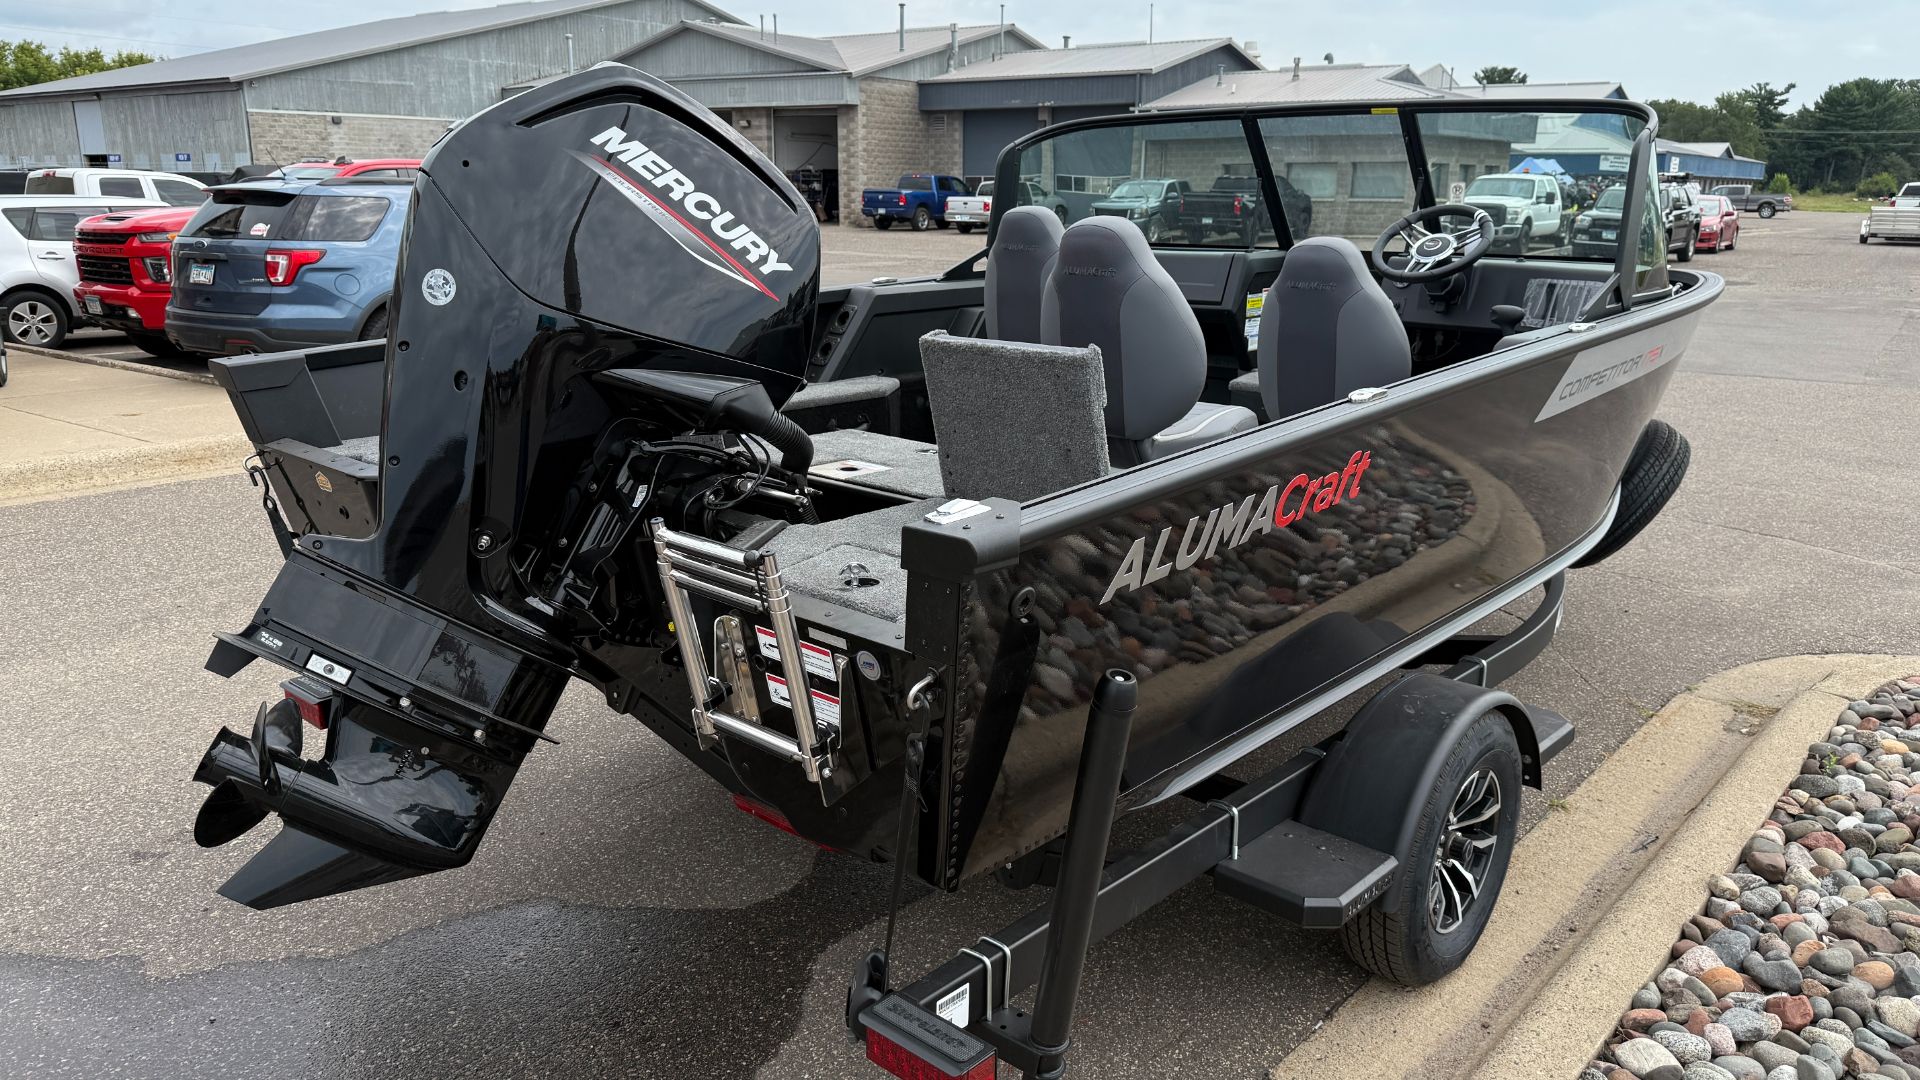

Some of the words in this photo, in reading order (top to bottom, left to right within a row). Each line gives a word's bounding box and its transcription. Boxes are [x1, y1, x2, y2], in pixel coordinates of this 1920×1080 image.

[589, 125, 794, 275] MERCURY
[73, 244, 124, 256] CHEVROLET
[1558, 353, 1645, 402] COMPETITOR
[1098, 448, 1372, 606] ALUMACraft
